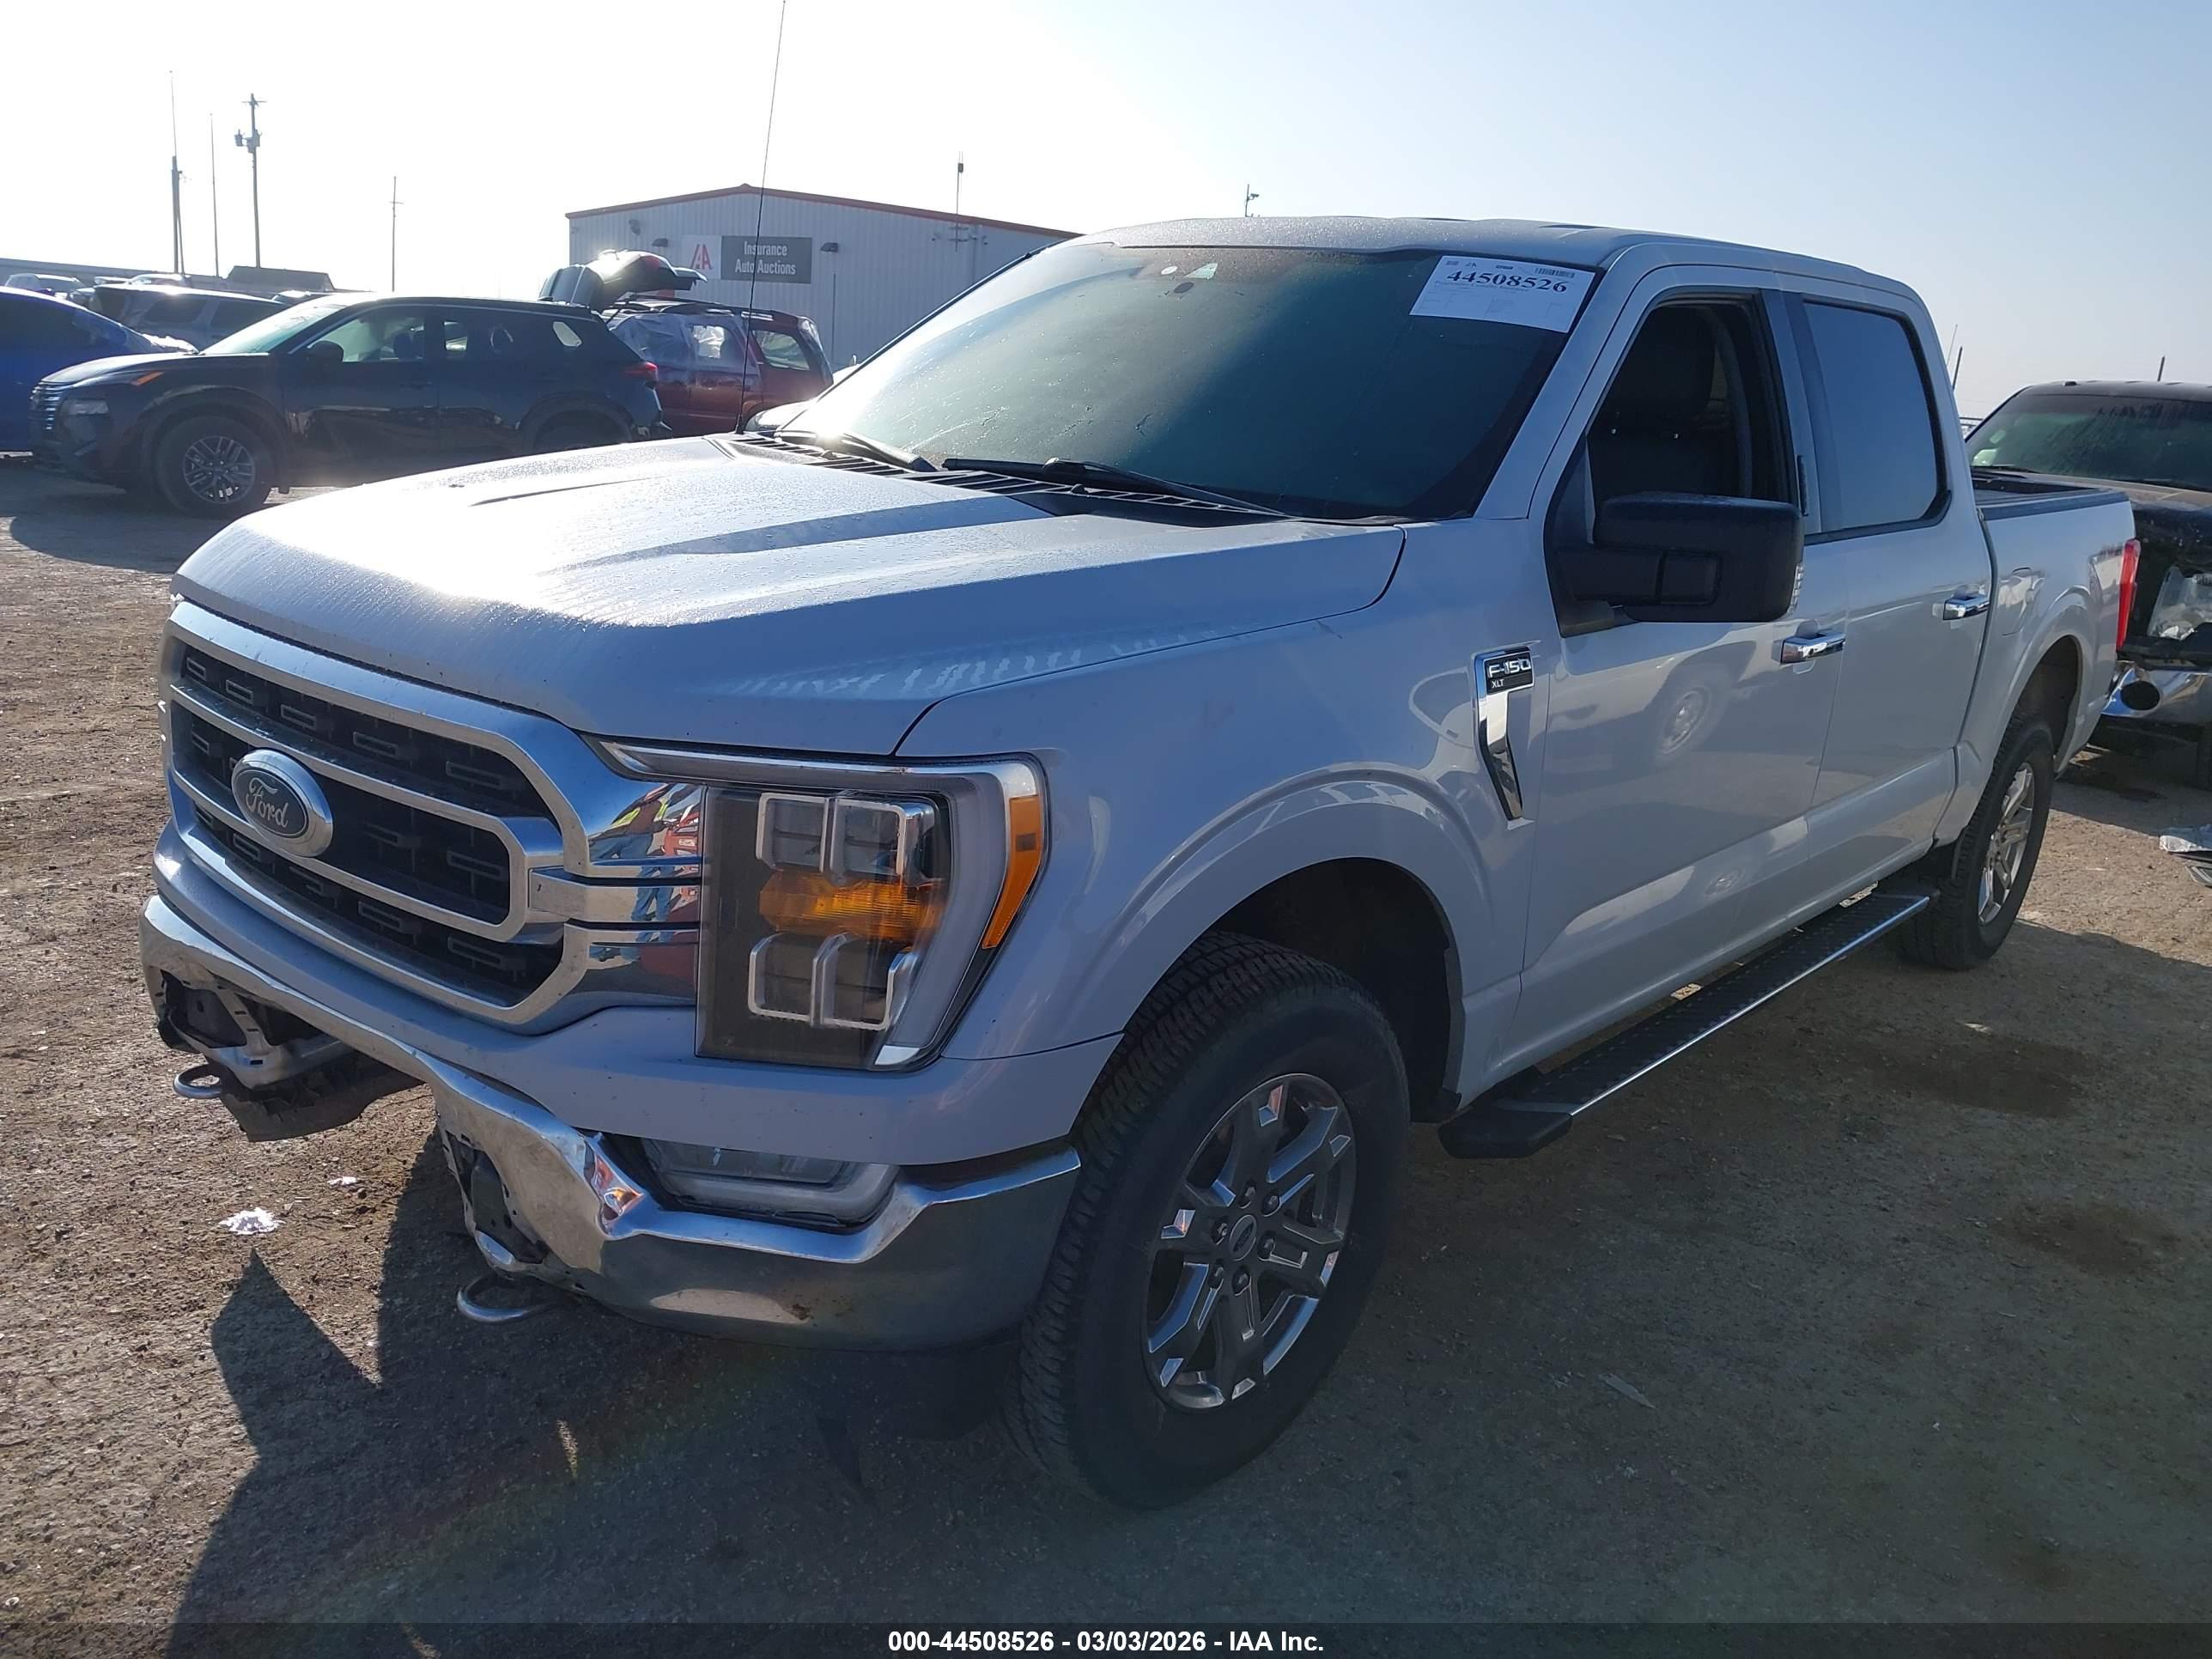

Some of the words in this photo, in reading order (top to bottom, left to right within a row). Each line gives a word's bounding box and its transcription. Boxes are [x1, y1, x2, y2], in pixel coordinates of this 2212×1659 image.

[744, 240, 787, 256] Insurance
[735, 259, 755, 273] Auto
[757, 259, 796, 275] Auctions
[1448, 270, 1568, 293] 44508526
[1488, 658, 1531, 678] F-150
[1492, 678, 1504, 689] XLT
[246, 777, 289, 828] Ford
